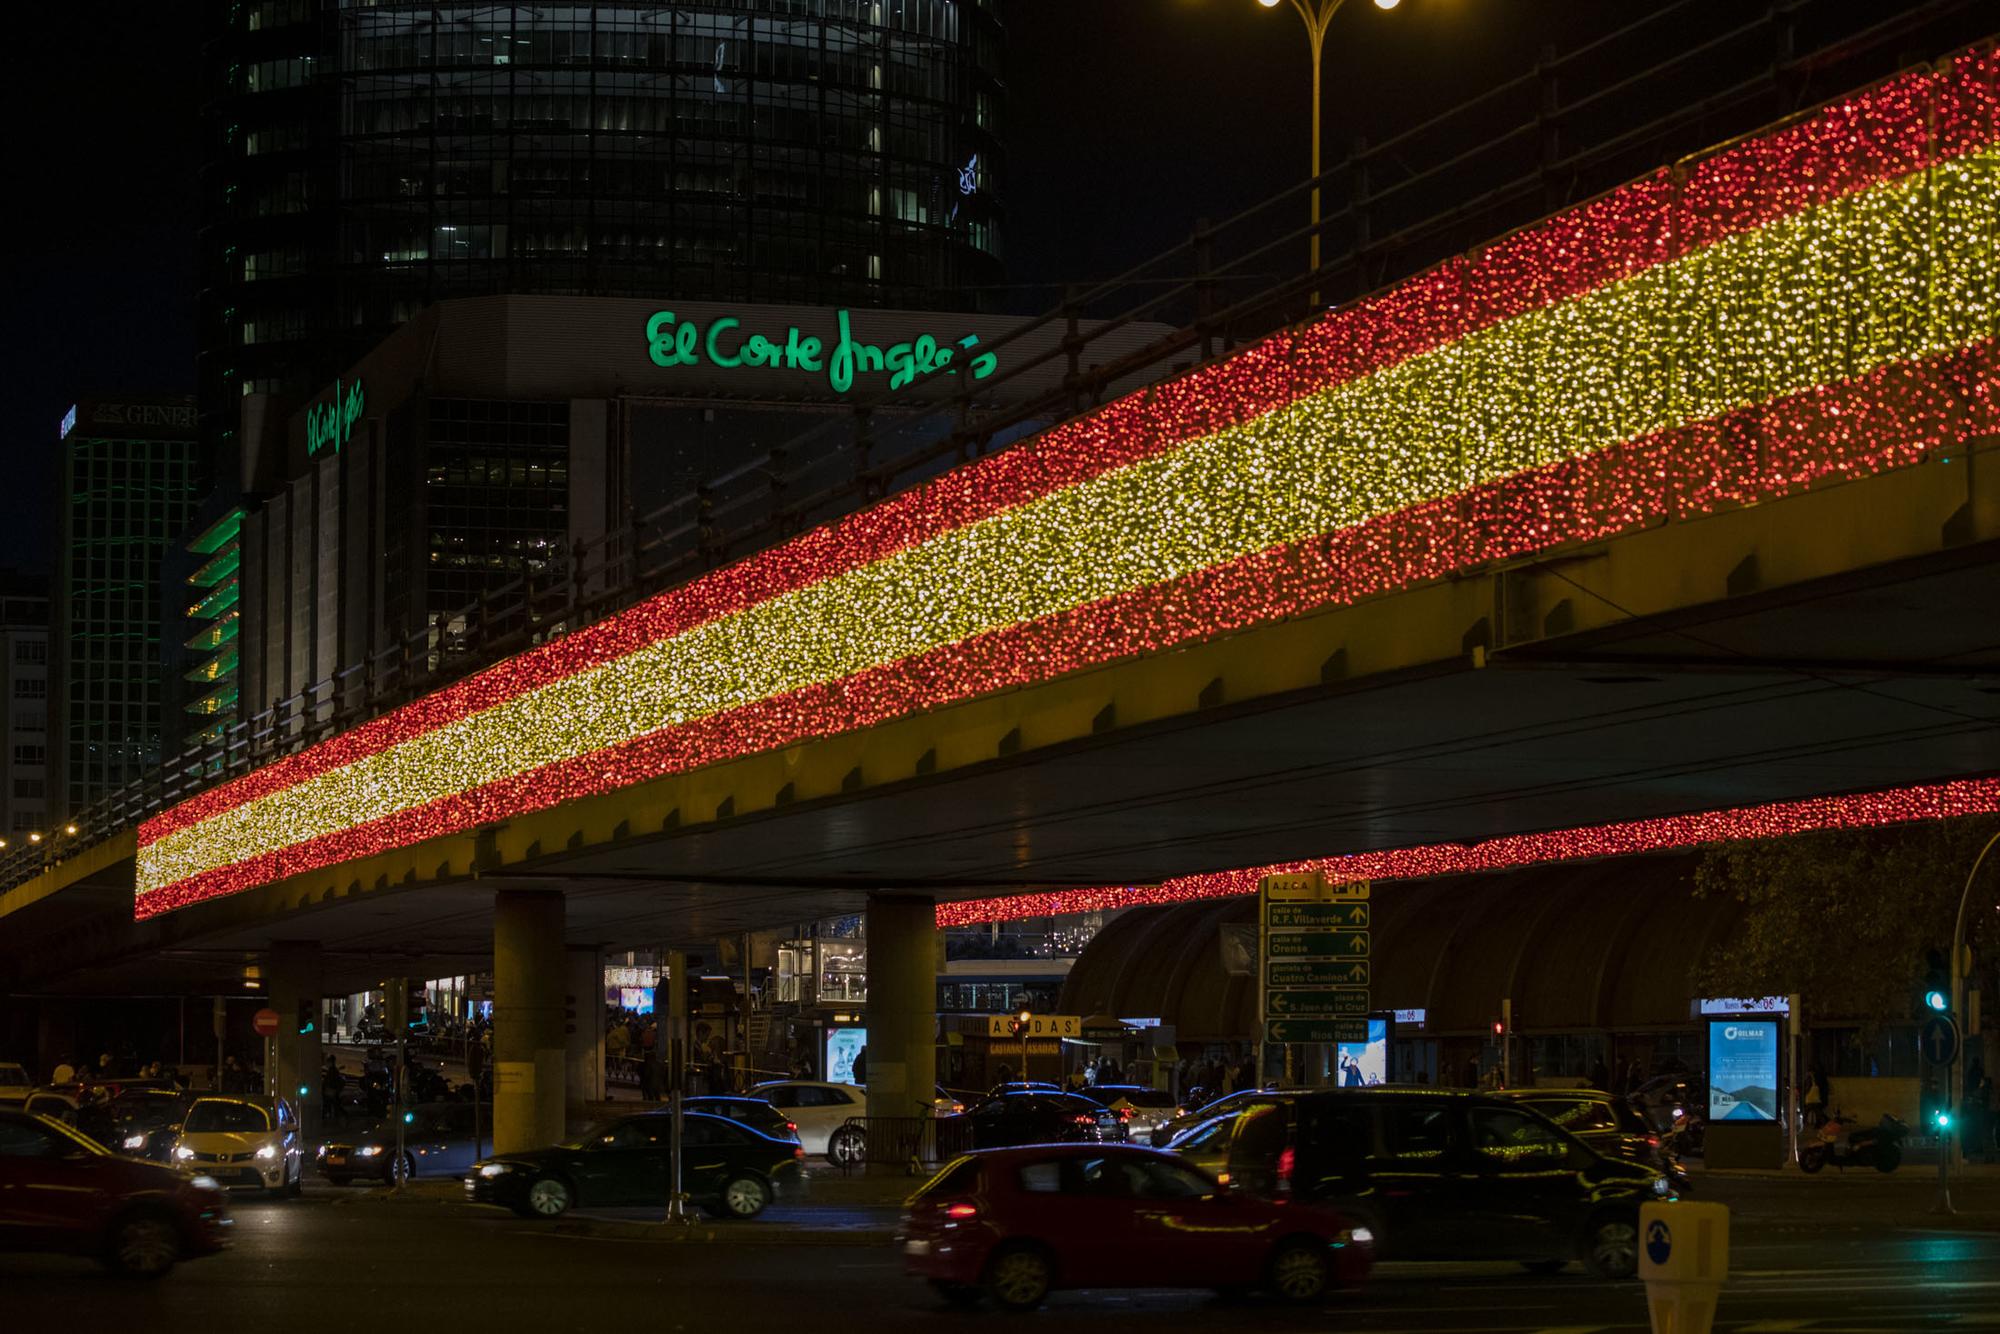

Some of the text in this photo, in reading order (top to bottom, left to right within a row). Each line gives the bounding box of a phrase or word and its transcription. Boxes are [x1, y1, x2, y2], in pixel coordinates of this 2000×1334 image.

[646, 310, 699, 368] El
[704, 316, 824, 373] Corte
[1272, 973, 1349, 982] Cuatro Caminos
[993, 1021, 1073, 1033] ASDAS
